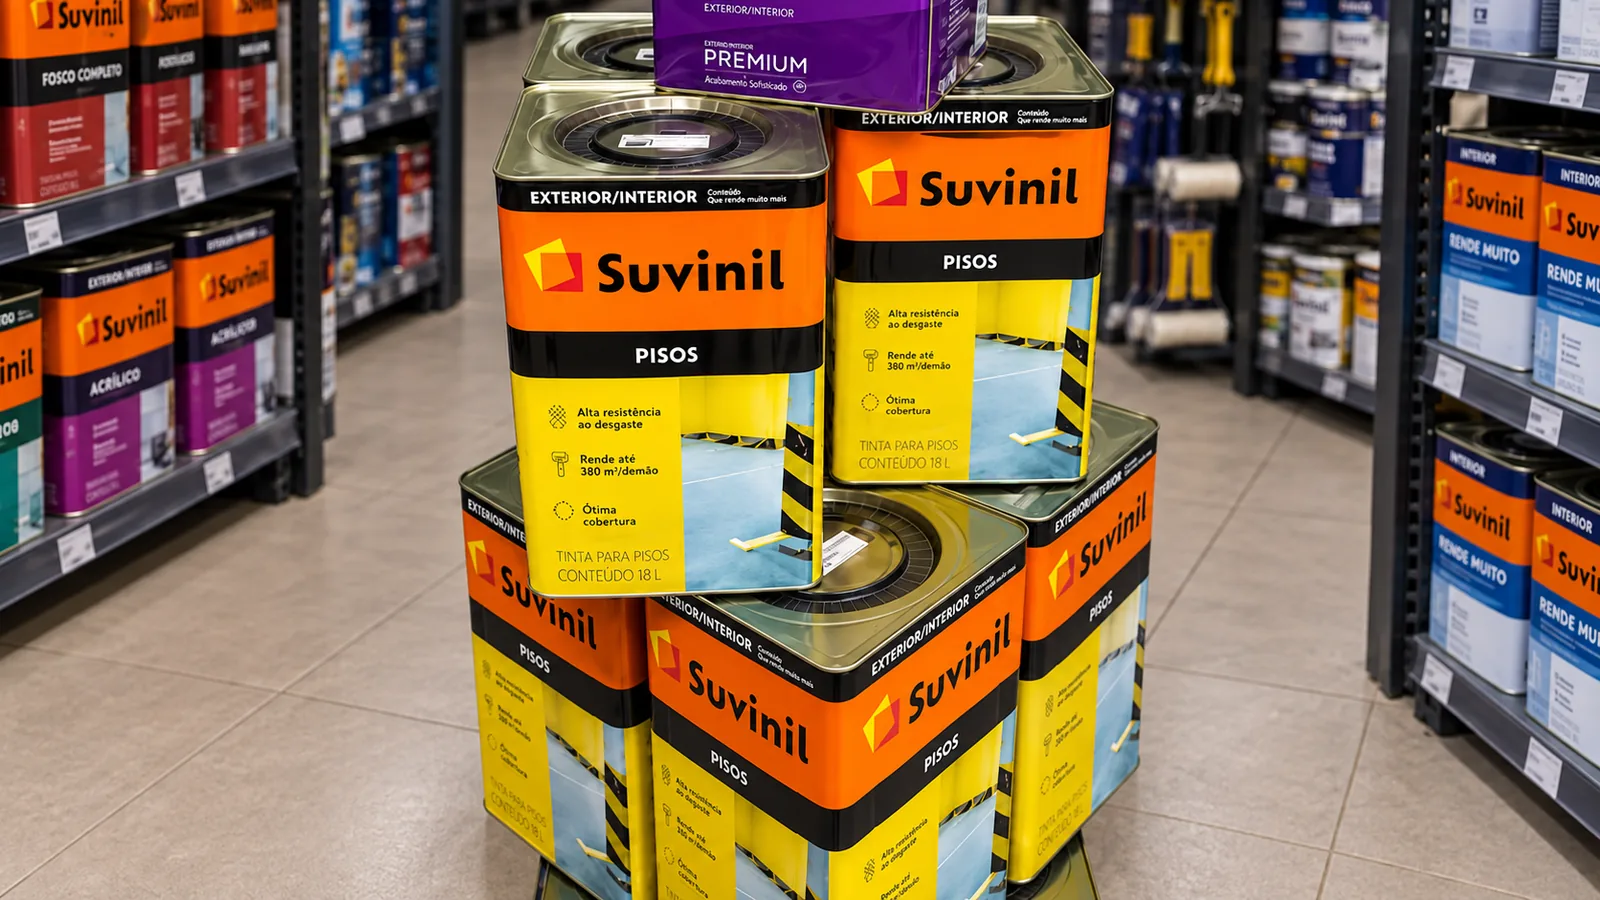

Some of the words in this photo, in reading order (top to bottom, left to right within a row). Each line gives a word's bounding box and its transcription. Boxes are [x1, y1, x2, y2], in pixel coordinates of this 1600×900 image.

[59, 0, 123, 29] Suvinil
[704, 3, 795, 18] EXTERIOR/INTERIOR
[704, 48, 808, 74] PREMIUM
[42, 69, 76, 87] FOSCO
[77, 63, 123, 82] COMPLETO
[749, 80, 788, 91] Sofisticado
[861, 111, 1008, 125] EXTERIOR/INTERIOR
[1460, 148, 1497, 165] INTERIOR
[920, 167, 1078, 206] Suvinil
[1560, 168, 1600, 188] INTERIOR
[530, 190, 697, 205] EXTERIOR/INTERIOR
[707, 188, 741, 196] Conteúdo
[707, 196, 723, 204] Que
[769, 195, 787, 203] mais
[1466, 188, 1524, 220] Suvinil
[1566, 212, 1600, 241] Suv
[1449, 232, 1480, 255] RENDE
[1482, 242, 1520, 265] MUITO
[597, 248, 784, 292] Suvinil
[943, 254, 997, 270] PISOS
[219, 259, 269, 298] Suvinil
[1547, 263, 1583, 288] RENDE
[102, 298, 167, 342] Suvinil
[888, 309, 907, 318] Alta
[910, 309, 959, 318] resistência
[902, 320, 943, 330] desgaste
[635, 347, 698, 364] PISOS
[887, 351, 917, 359] Rende
[919, 351, 934, 359] até
[887, 362, 904, 370] 380
[89, 367, 141, 397] ACRÍLICO
[886, 394, 916, 405] Ótima
[886, 406, 931, 415] cobertura
[577, 408, 600, 417] Alta
[603, 407, 661, 417] resistência
[594, 420, 643, 431] desgaste
[859, 440, 892, 451] TINTA
[895, 440, 924, 451] PARA
[927, 440, 958, 451] PISOS
[580, 454, 615, 464] Rende
[618, 454, 636, 463] até
[580, 466, 601, 476] 380
[859, 455, 927, 469] CONTEÚDO
[930, 457, 942, 468] 18
[945, 457, 951, 468] L
[1450, 450, 1486, 479] INTERIOR
[582, 503, 617, 515] Ótima
[1055, 470, 1122, 533] EXTERIOR/INTERIOR
[468, 498, 526, 543] EXTERIOR/INTE
[583, 517, 636, 526] cobertura
[1454, 494, 1511, 541] Suvinil
[1552, 502, 1593, 534] INTERIOR
[1080, 491, 1147, 578] Suvinil
[556, 551, 594, 563] TINTA
[596, 551, 632, 563] PARA
[634, 549, 669, 562] PISOS
[1438, 534, 1468, 565] RENDE
[1470, 555, 1507, 586] MUITO
[558, 566, 634, 582] CONTEÚDO
[638, 568, 652, 581] 18
[653, 568, 661, 580] L
[501, 565, 596, 650] Suvinil
[1089, 590, 1113, 622] PISOS
[1539, 596, 1575, 632] RENDE
[871, 594, 970, 676] EXTERIOR/INTERIOR
[519, 643, 550, 674] PISOS
[909, 612, 1010, 724] Suvinil
[688, 660, 808, 764] Suvinil
[924, 733, 959, 773] PISOS
[711, 750, 748, 786] PISOS
